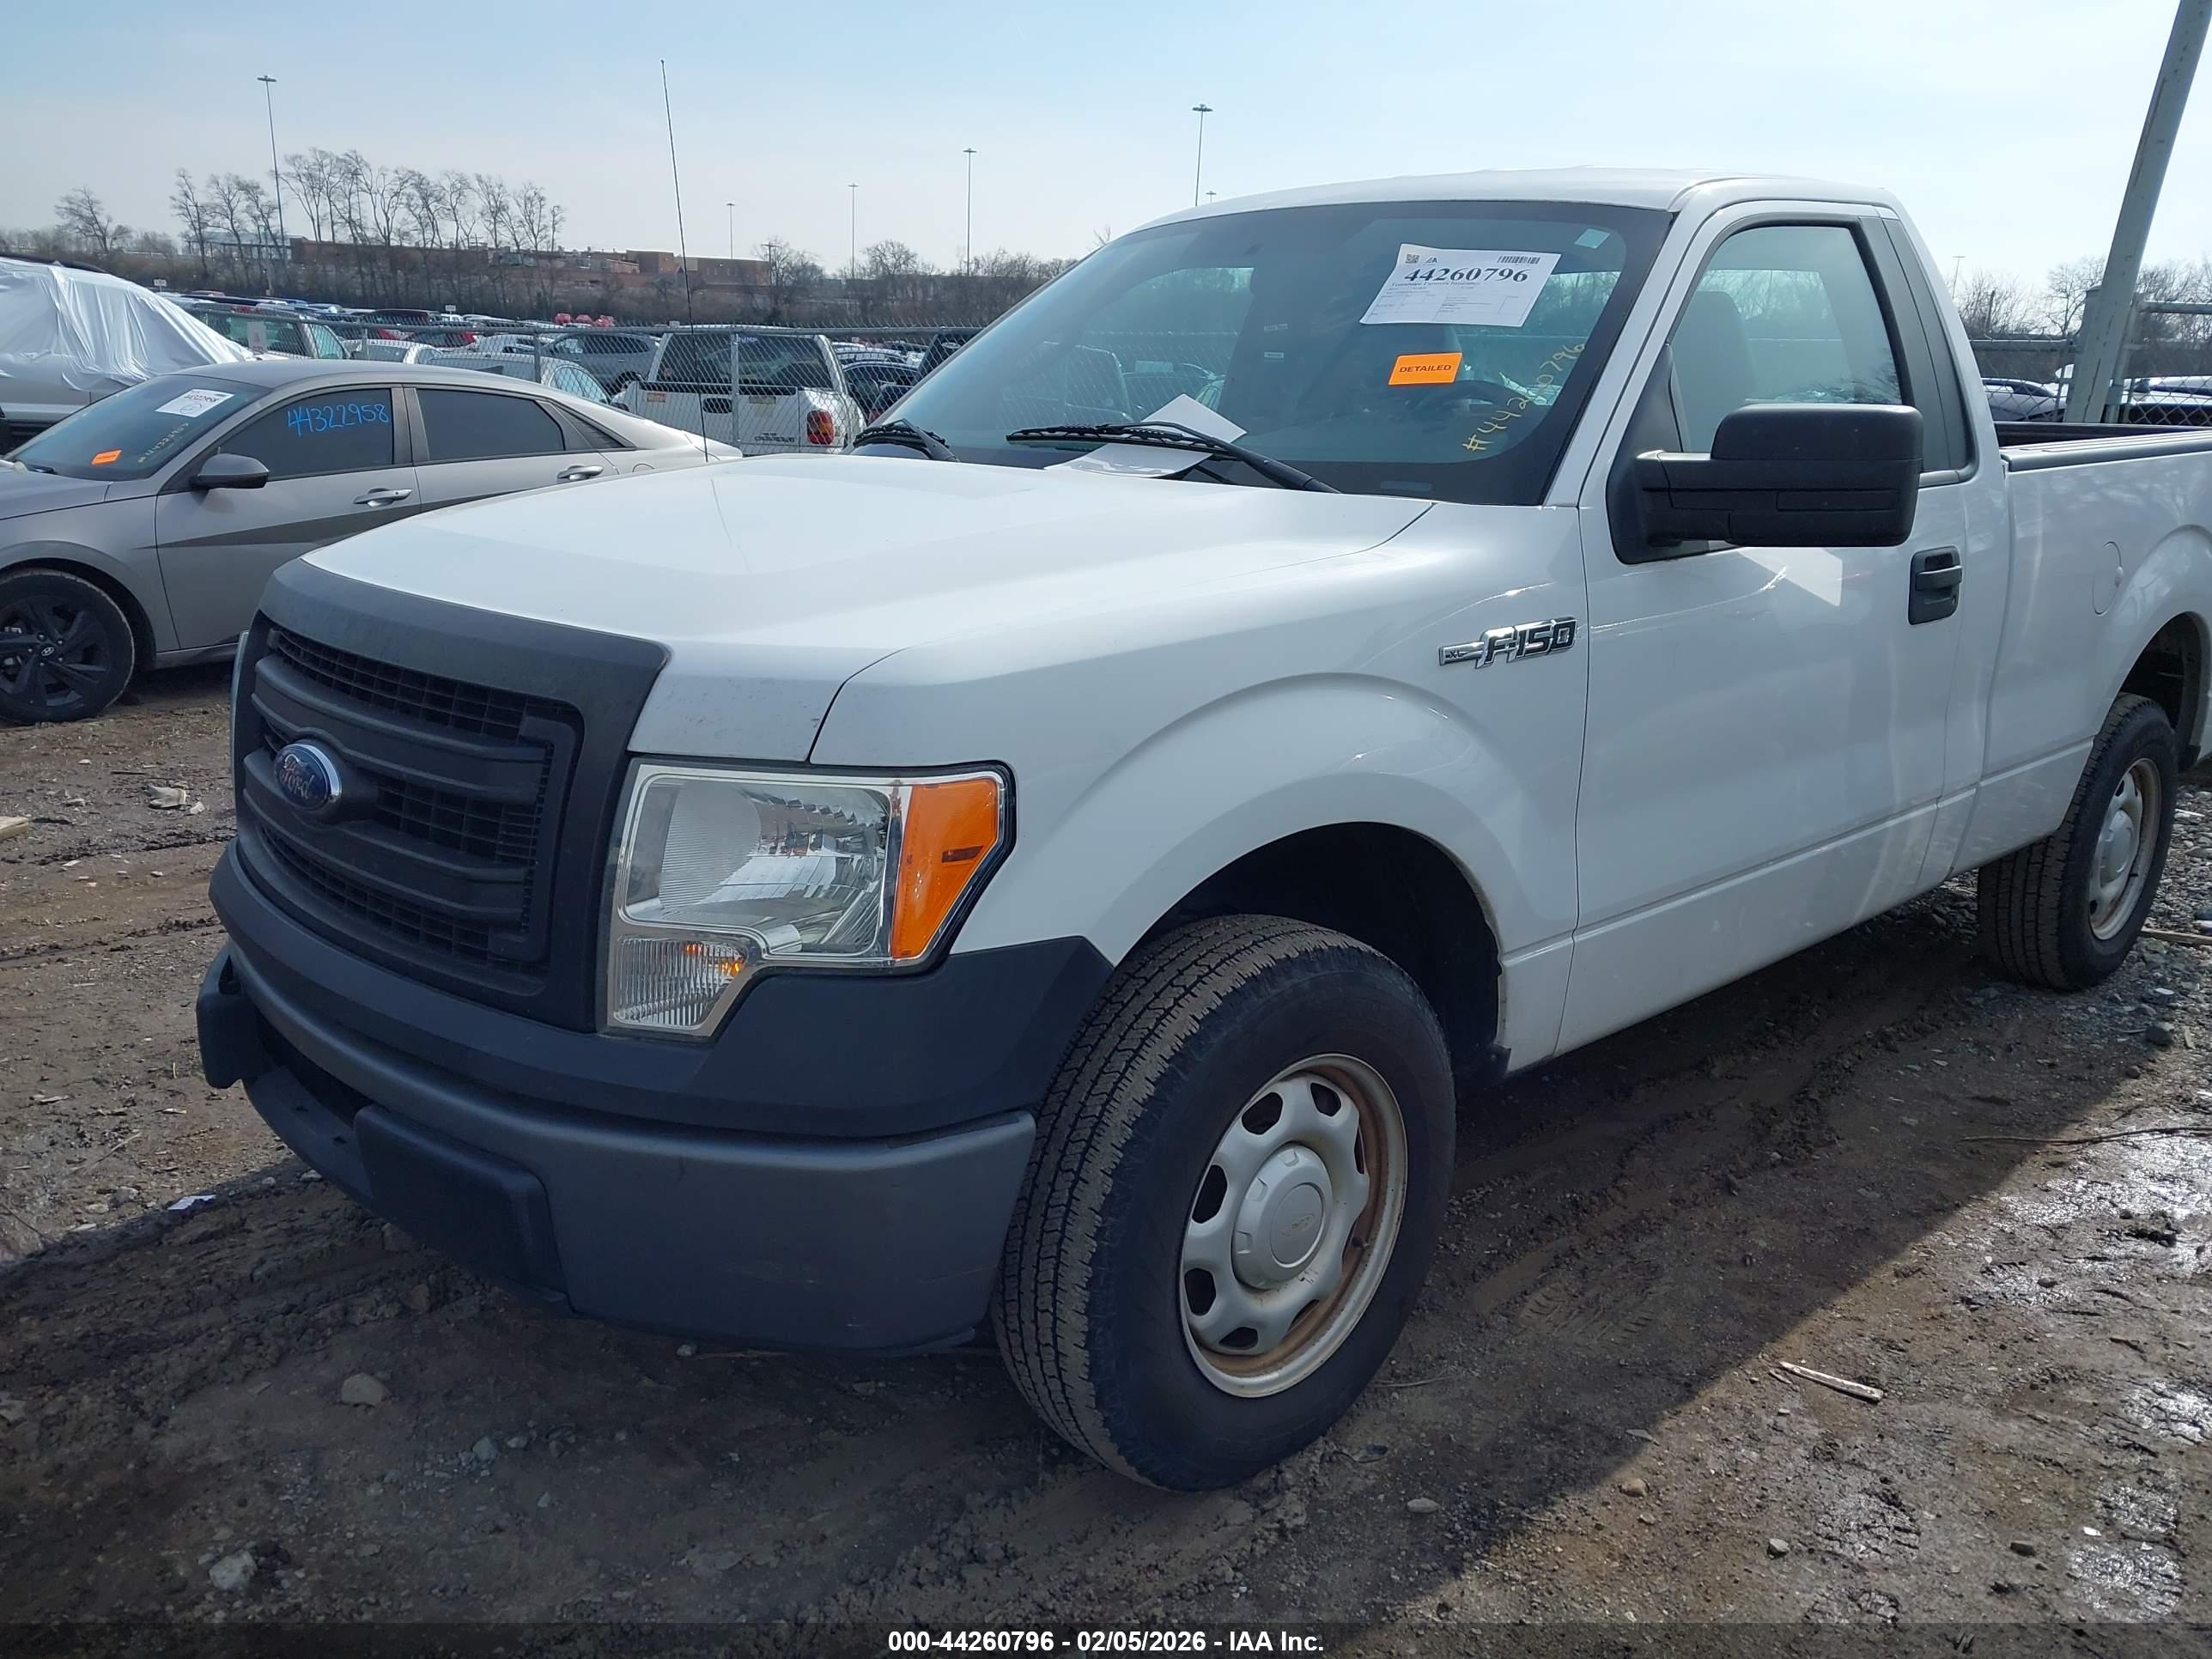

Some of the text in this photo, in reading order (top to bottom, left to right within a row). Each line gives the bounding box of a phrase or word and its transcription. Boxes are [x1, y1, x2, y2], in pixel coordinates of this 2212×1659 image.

[1404, 267, 1531, 283] 44260796
[1399, 364, 1452, 373] DETAILED
[288, 404, 389, 436] 44322958
[1475, 617, 1577, 669] F-150
